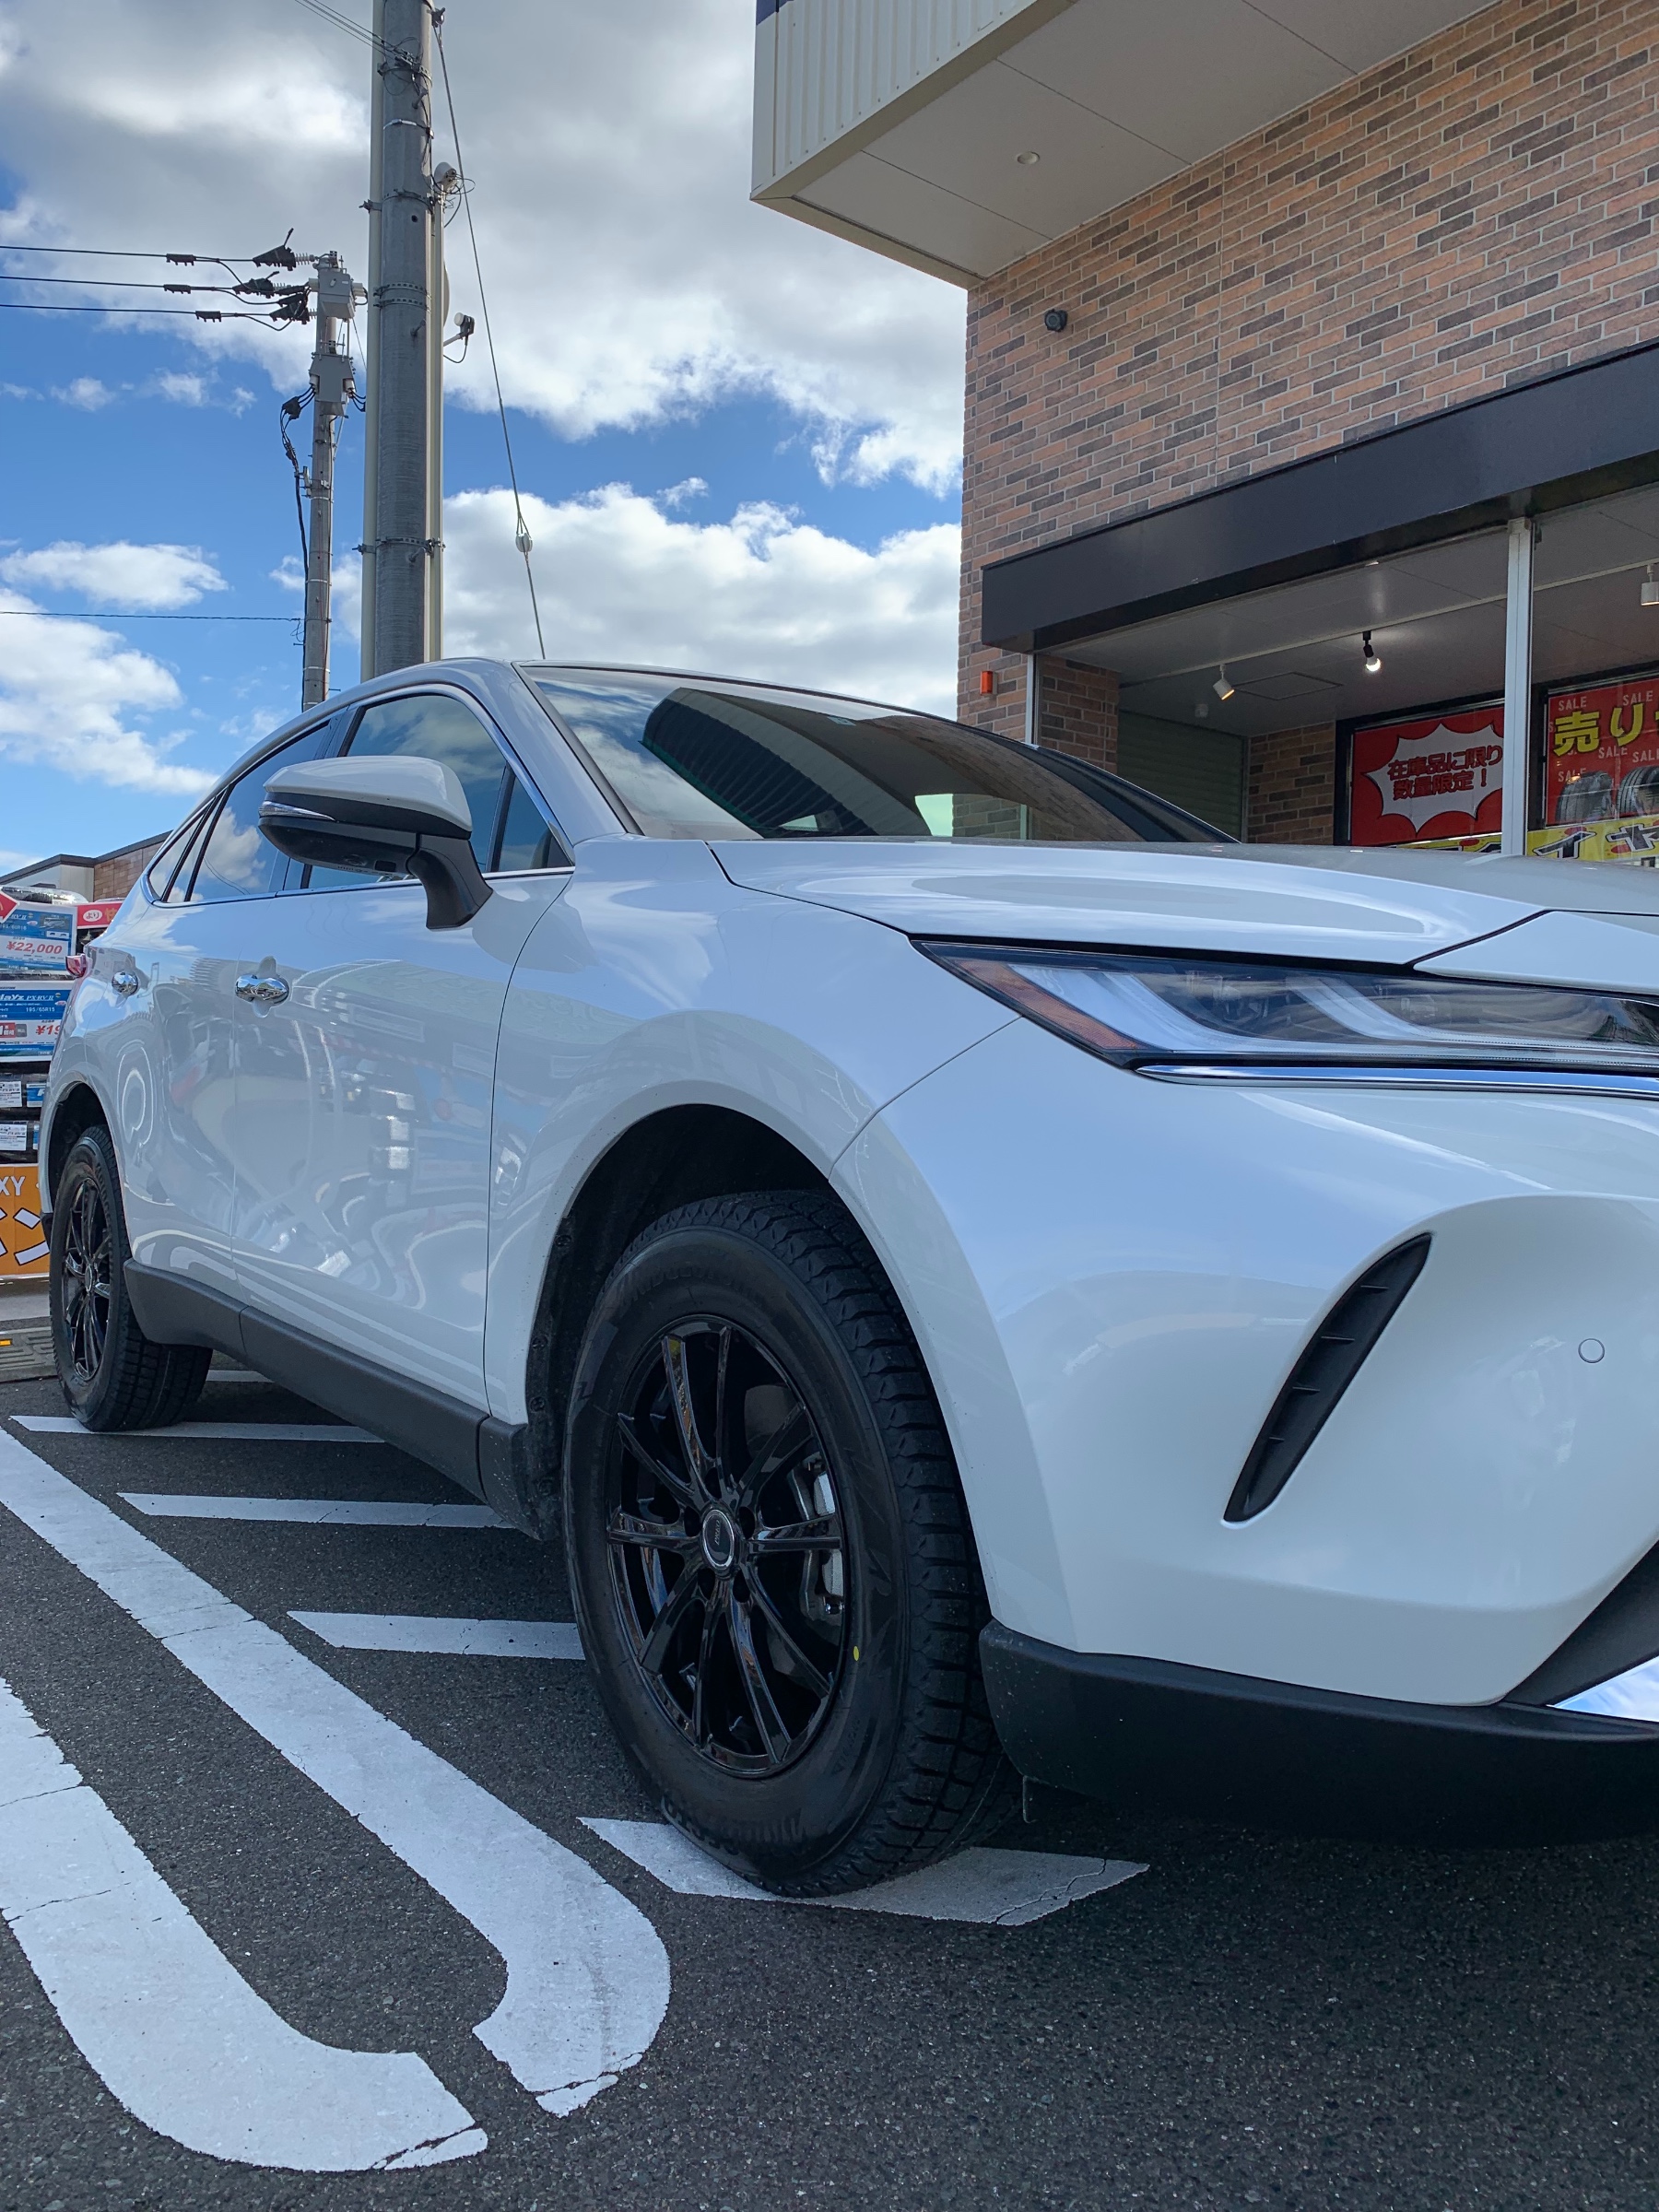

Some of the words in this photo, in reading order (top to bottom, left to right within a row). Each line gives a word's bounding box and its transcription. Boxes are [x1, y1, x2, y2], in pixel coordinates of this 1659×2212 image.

[1559, 696, 1587, 712] SALE
[1622, 690, 1653, 706] SALE
[1553, 702, 1659, 757] 売り
[1598, 746, 1629, 759] SALE
[1387, 745, 1503, 781] 在庫品に限り
[86, 912, 100, 920] より
[6, 940, 63, 955] ¥22,000
